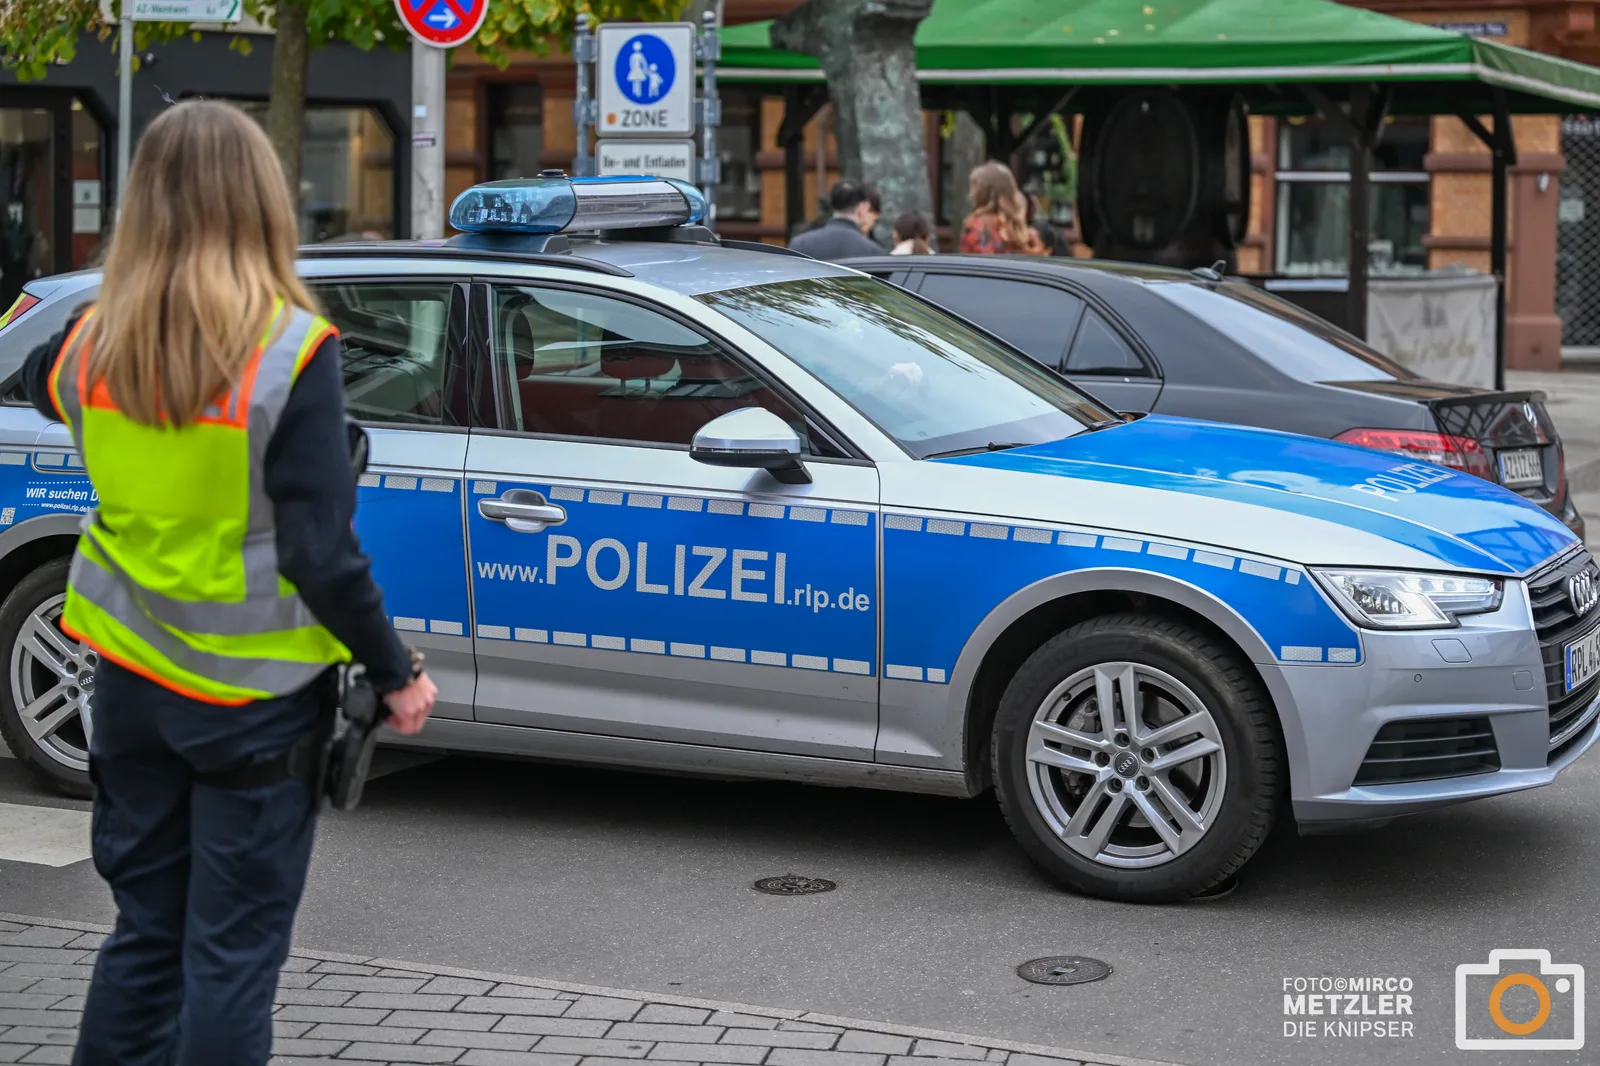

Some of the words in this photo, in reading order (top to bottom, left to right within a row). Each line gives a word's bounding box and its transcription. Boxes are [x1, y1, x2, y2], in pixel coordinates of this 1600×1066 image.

[621, 109, 669, 127] ZONE
[623, 156, 640, 168] und
[644, 154, 686, 169] Entladen
[26, 487, 47, 499] WIR
[48, 488, 88, 501] suchen
[90, 488, 101, 502] D
[1350, 463, 1457, 502] POLIZEI
[477, 534, 870, 613] www.POLIZEI.rlp.de
[1572, 644, 1587, 683] RPL
